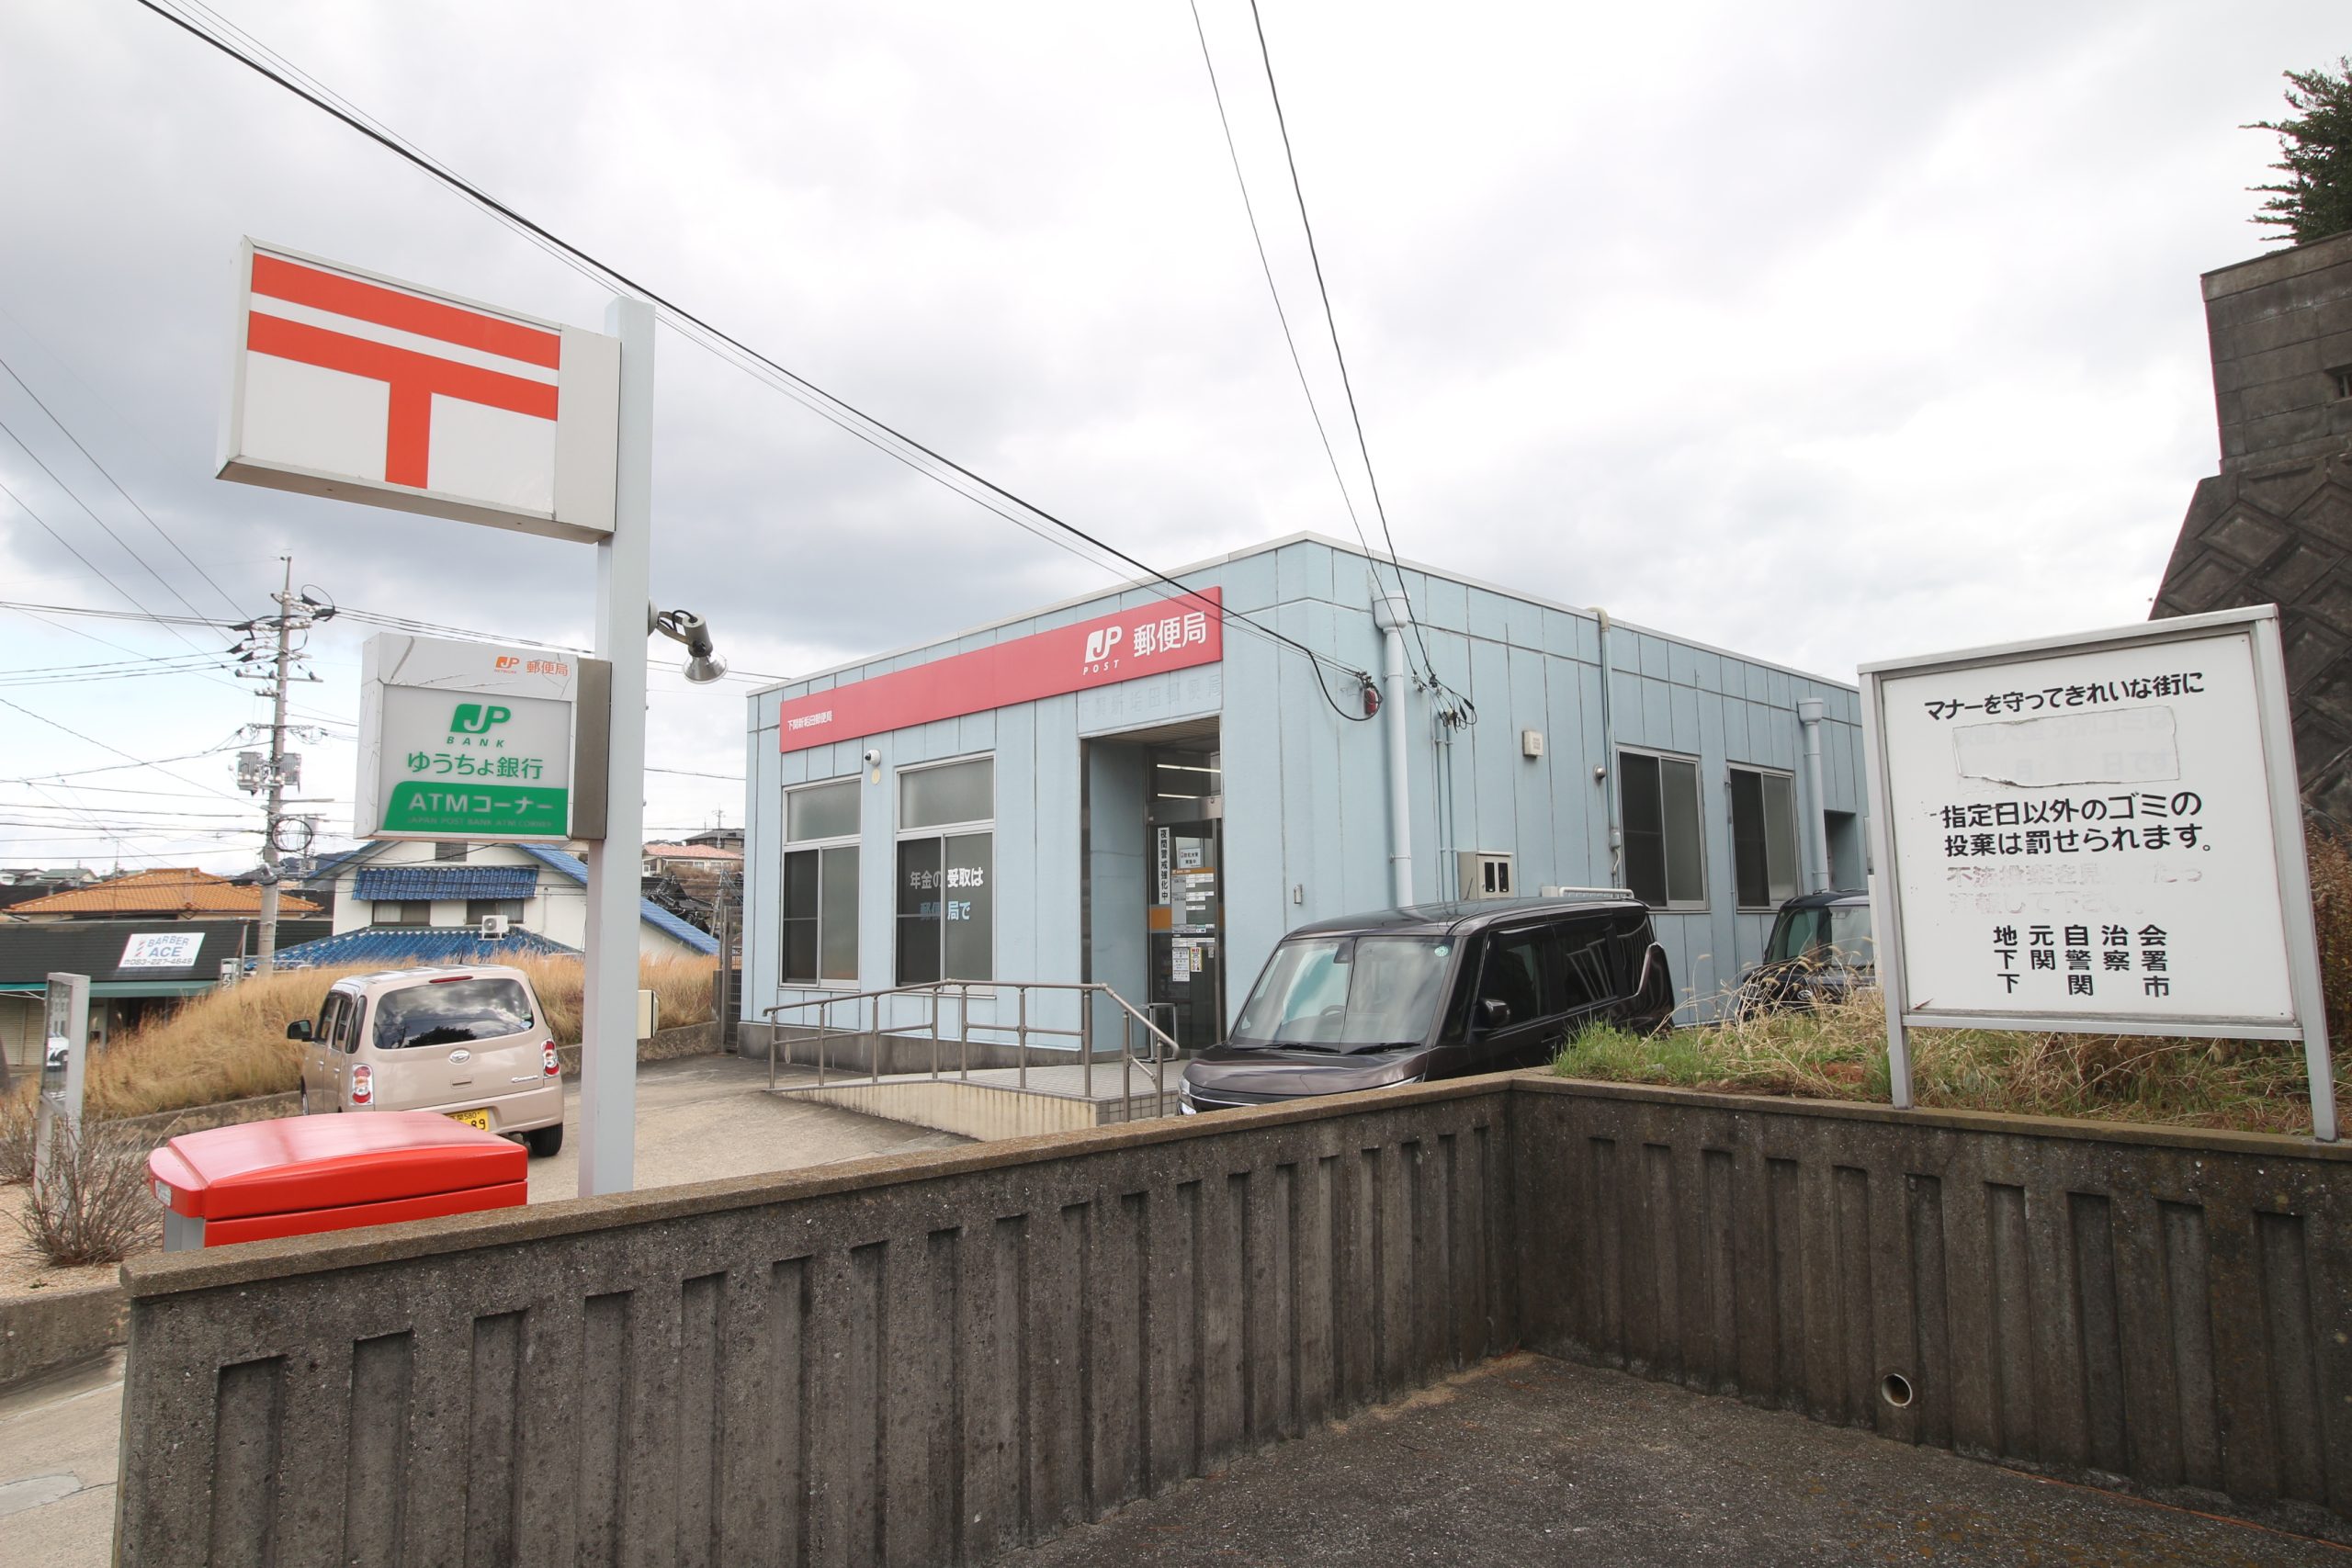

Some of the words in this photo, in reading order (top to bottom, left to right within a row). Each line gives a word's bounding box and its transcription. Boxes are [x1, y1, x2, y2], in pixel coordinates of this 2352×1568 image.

[1133, 611, 1206, 658] 郵便局
[526, 660, 569, 677] 郵便局
[1082, 659, 1119, 676] POST
[1924, 671, 2205, 721] マナーを守ってきれいな街に
[447, 736, 506, 749] BANK
[407, 750, 544, 780] ゆうちょ銀行
[408, 793, 554, 815] ATMコーナー
[1942, 791, 2202, 829] 指定日以外のゴミの
[1944, 823, 2211, 858] 投棄は罰せられます。
[1159, 829, 1169, 901] 夜間警戒強化中
[147, 935, 190, 948] BARBER
[1993, 924, 2167, 947] 地元自治会
[148, 946, 184, 957] ACE
[1994, 949, 2168, 972] 下関警察署
[1997, 974, 2170, 998] 下関市
